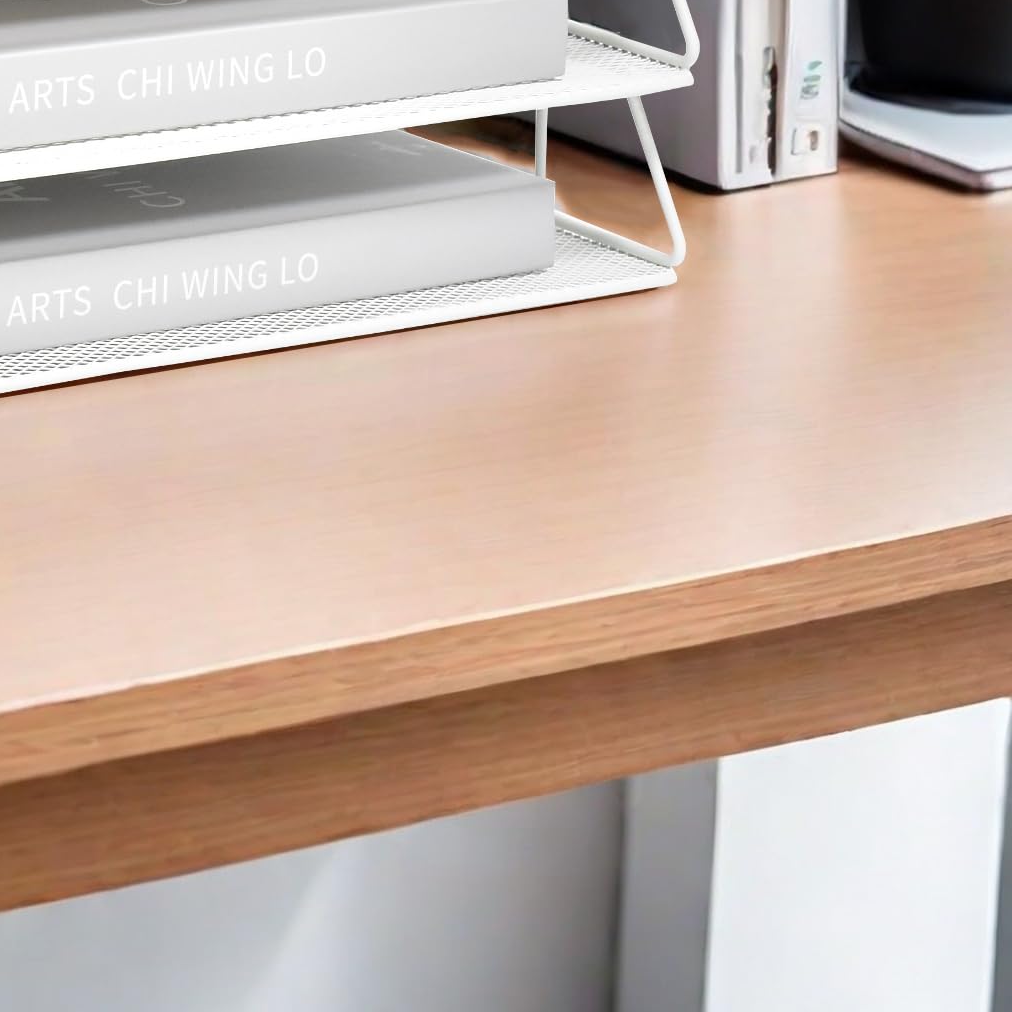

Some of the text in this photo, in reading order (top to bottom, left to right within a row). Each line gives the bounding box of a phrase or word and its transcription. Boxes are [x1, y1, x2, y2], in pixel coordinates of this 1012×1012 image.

[8, 45, 327, 115] ARTS CHI WING LO
[6, 252, 320, 327] ARTS CHI WING LO
